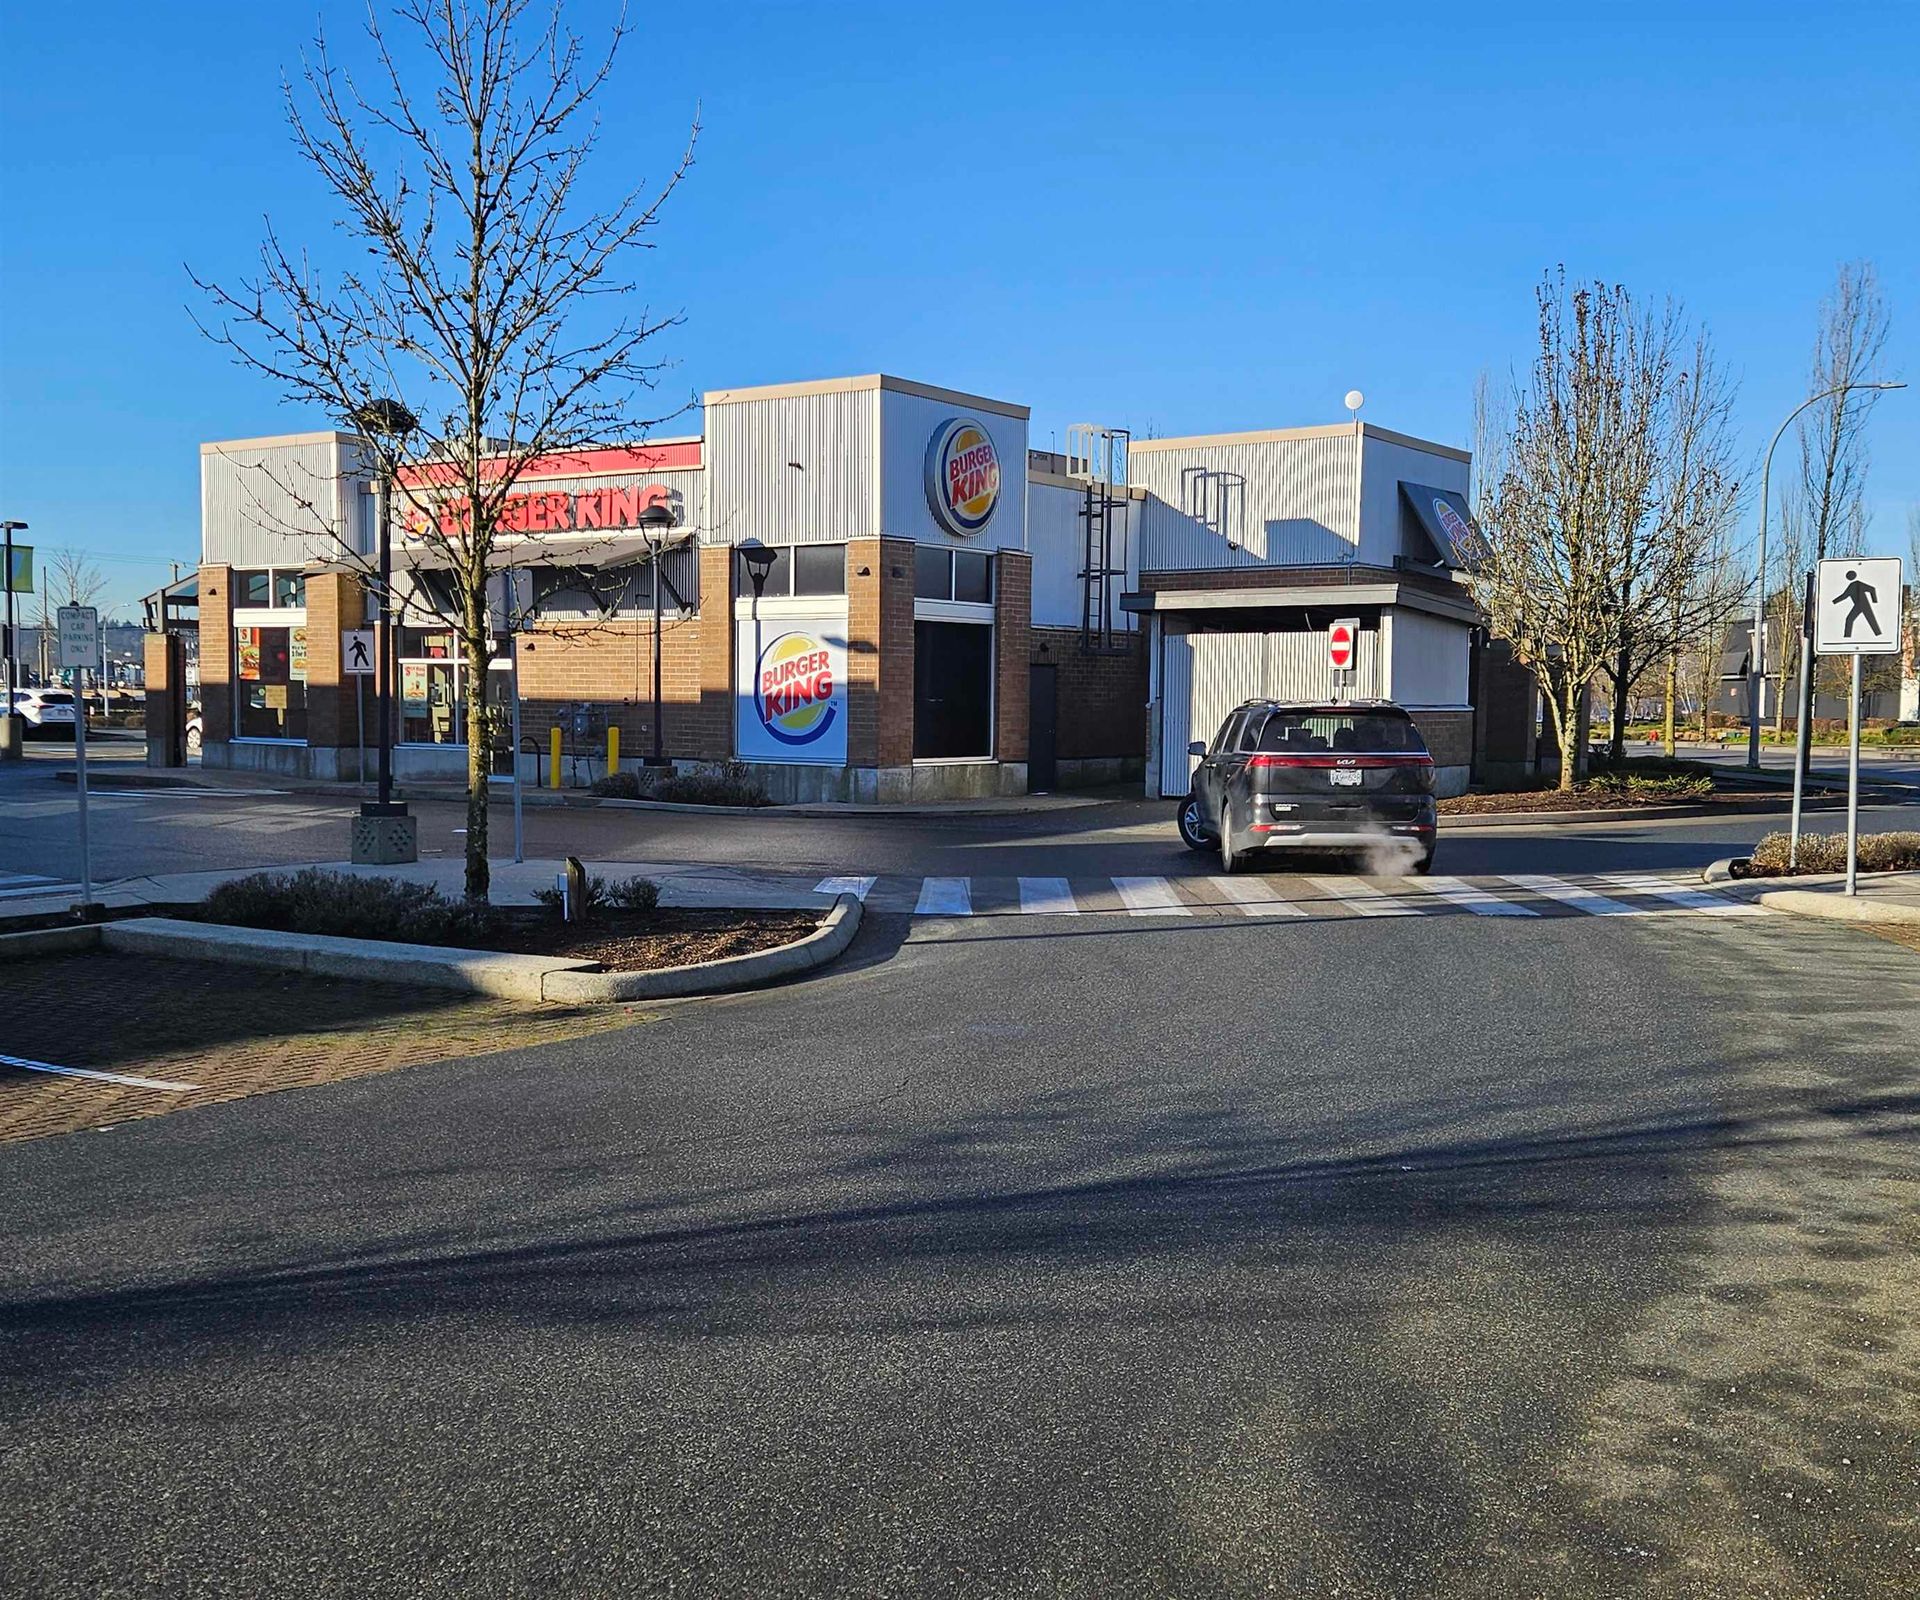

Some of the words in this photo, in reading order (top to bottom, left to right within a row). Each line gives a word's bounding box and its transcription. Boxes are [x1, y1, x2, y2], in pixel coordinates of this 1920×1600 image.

[949, 445, 994, 481] BURGER
[952, 462, 997, 508] KING
[438, 491, 572, 536] BGER
[576, 484, 668, 529] KING
[60, 610, 94, 620] COMPACT
[70, 622, 85, 631] CAR
[63, 633, 94, 642] PARKING
[70, 644, 88, 654] ONLY
[762, 651, 830, 693] BURGER
[765, 671, 833, 721] KING
